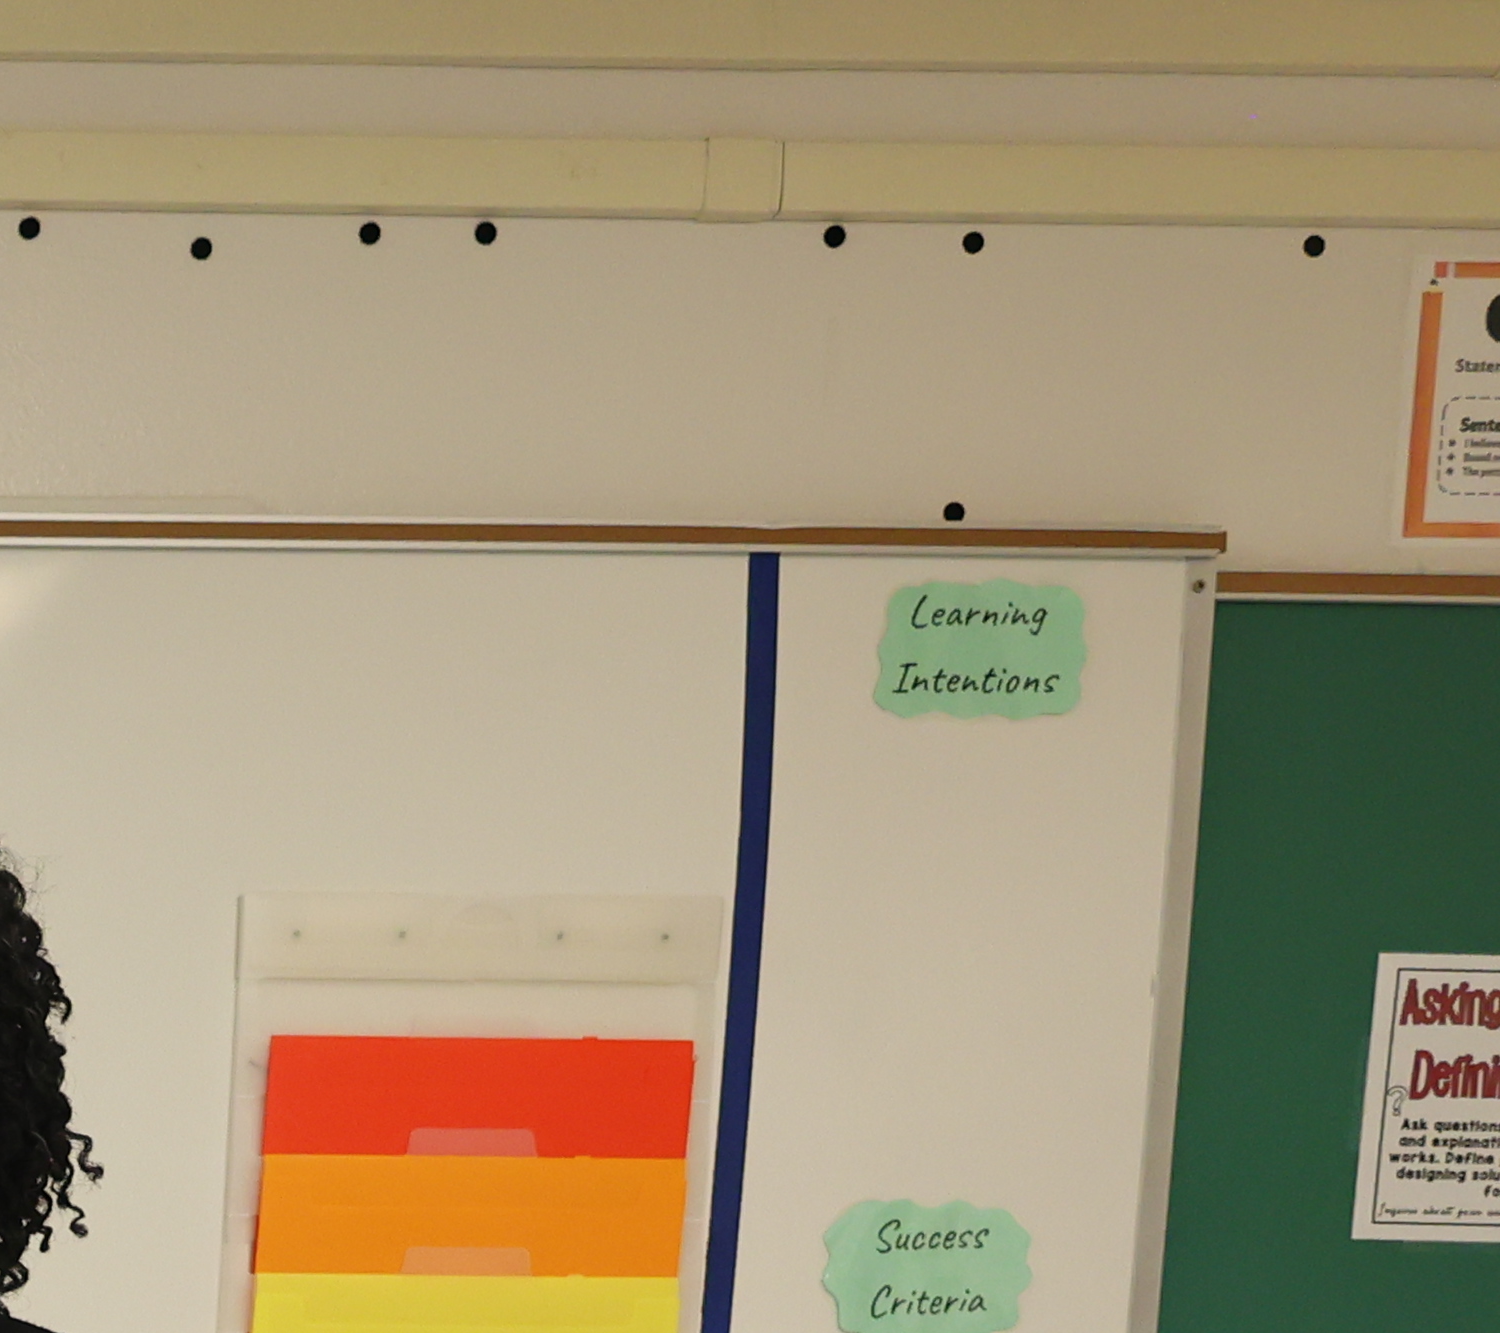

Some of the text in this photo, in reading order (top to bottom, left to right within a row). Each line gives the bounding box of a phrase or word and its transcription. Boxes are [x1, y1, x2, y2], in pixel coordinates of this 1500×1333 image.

[909, 593, 1050, 637] Learning
[891, 660, 1062, 700] Intentions
[1400, 1117, 1428, 1131] Ask
[1399, 1134, 1426, 1147] and
[1388, 1151, 1494, 1164] works. Define
[1396, 1166, 1466, 1184] designing
[875, 1218, 992, 1255] Success
[870, 1283, 988, 1320] Criteria
